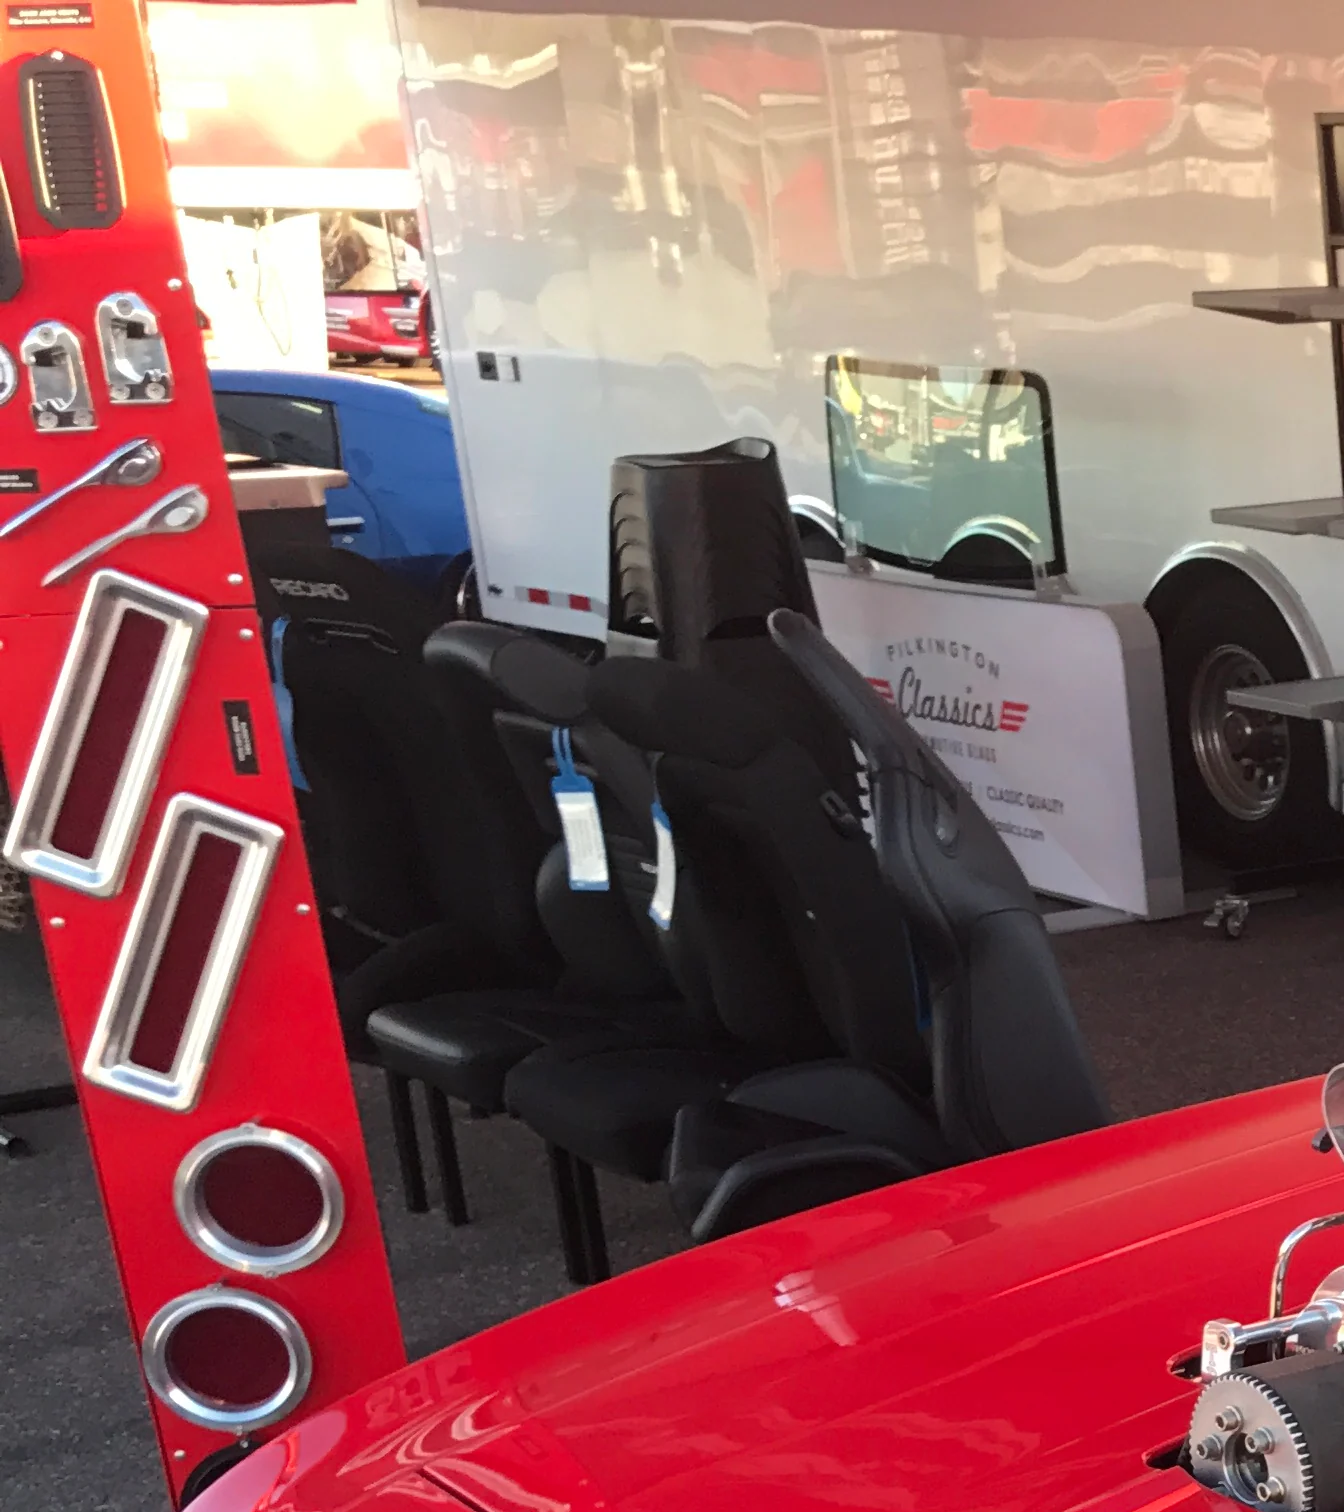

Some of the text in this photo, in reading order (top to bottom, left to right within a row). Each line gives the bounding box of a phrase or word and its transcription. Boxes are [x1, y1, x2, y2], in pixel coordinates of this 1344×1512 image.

[269, 577, 350, 601] RECARO
[885, 638, 1000, 679] PILKINGTON
[898, 666, 998, 732] Classics
